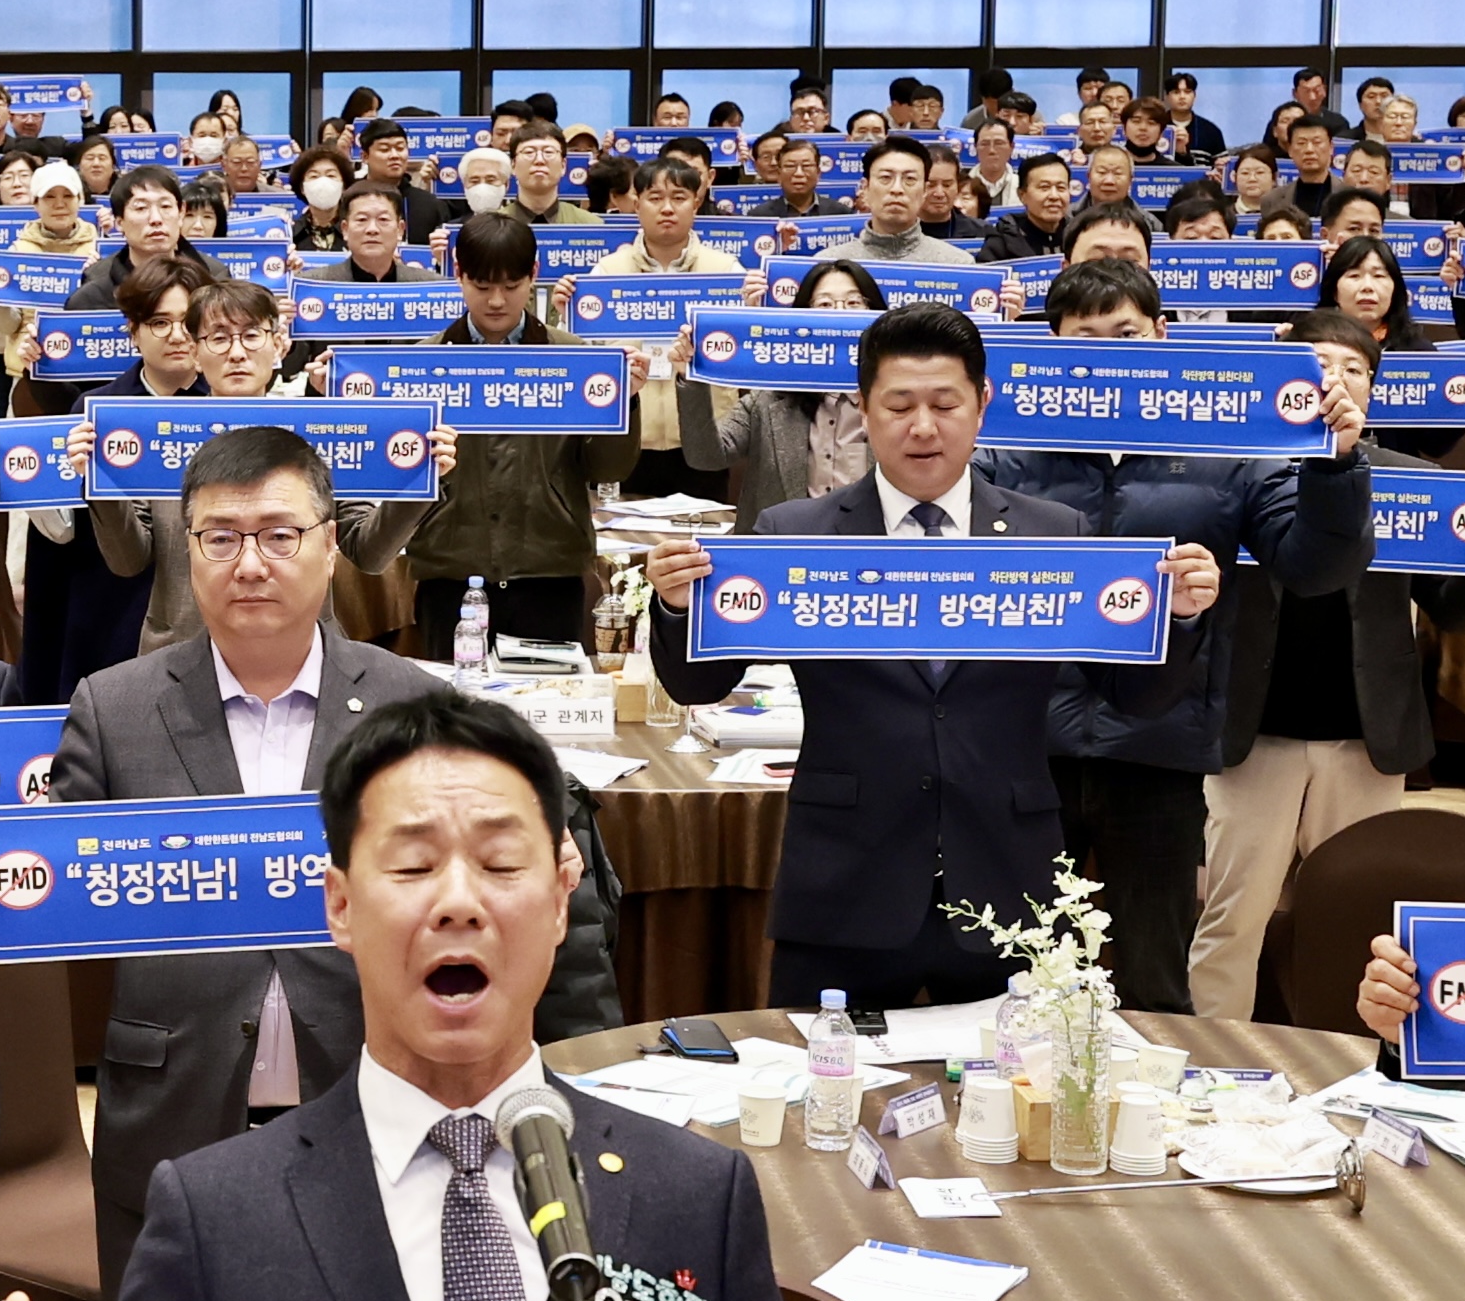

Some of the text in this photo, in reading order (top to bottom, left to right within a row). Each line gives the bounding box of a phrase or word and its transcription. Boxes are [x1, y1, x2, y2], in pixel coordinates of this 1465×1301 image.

[483, 381, 574, 408] 방역실천!”
[1001, 382, 1262, 424] “청정전남! 방역실천!”
[808, 570, 850, 583] 전라남도
[720, 592, 762, 611] FMD
[777, 590, 1083, 627] “청정전남! 방역실천!”
[1104, 591, 1142, 609] ASF
[558, 709, 604, 724] 관계자
[66, 857, 238, 907] “청정전남!
